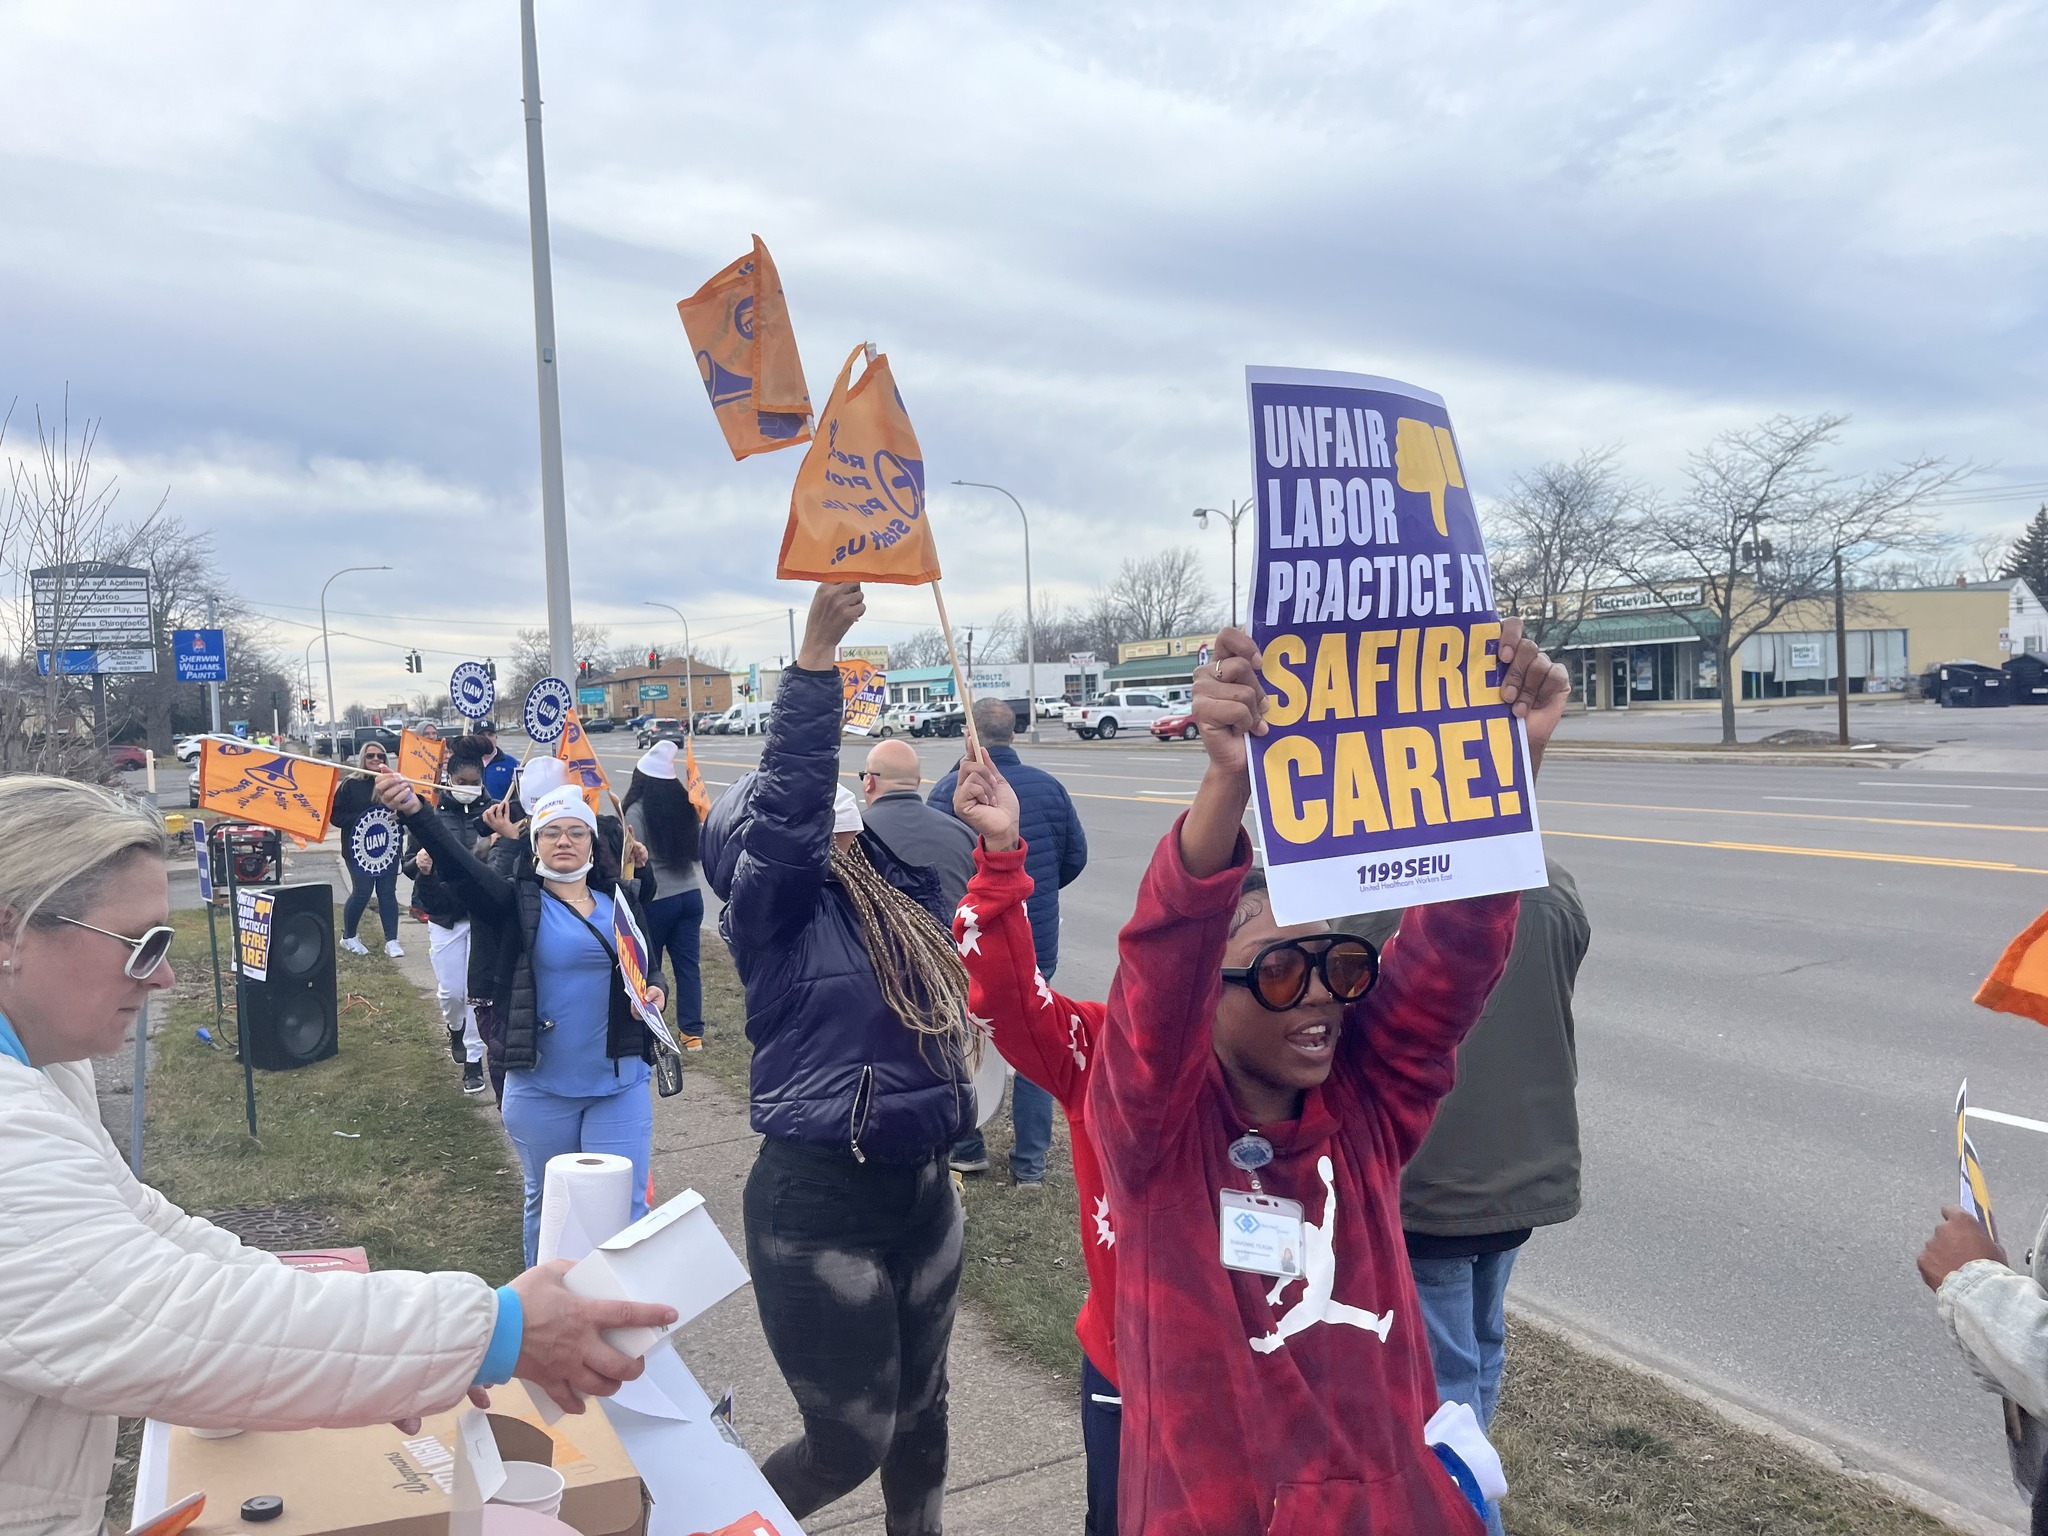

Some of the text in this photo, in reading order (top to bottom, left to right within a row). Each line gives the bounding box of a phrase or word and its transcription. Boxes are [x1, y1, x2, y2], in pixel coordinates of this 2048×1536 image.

[1263, 405, 1391, 468] UNFAIR
[1268, 477, 1399, 549] LABOR
[1265, 554, 1494, 626] PRACTICE AT
[1595, 592, 1652, 610] Retrieval
[179, 654, 220, 663] SHERWIN
[186, 671, 217, 679] PAINTS
[1259, 622, 1505, 727] SAFIRE
[464, 681, 482, 699] UAW
[1263, 717, 1522, 844] CARE!
[366, 832, 386, 850] UAW
[1357, 854, 1450, 884] 1199SEIU
[1360, 873, 1452, 892] United Healthcare Workers East
[241, 929, 268, 950] AFIRE
[242, 946, 266, 969] ARE!
[402, 1436, 454, 1467] NIGHT
[384, 1452, 434, 1494] Wegmans
